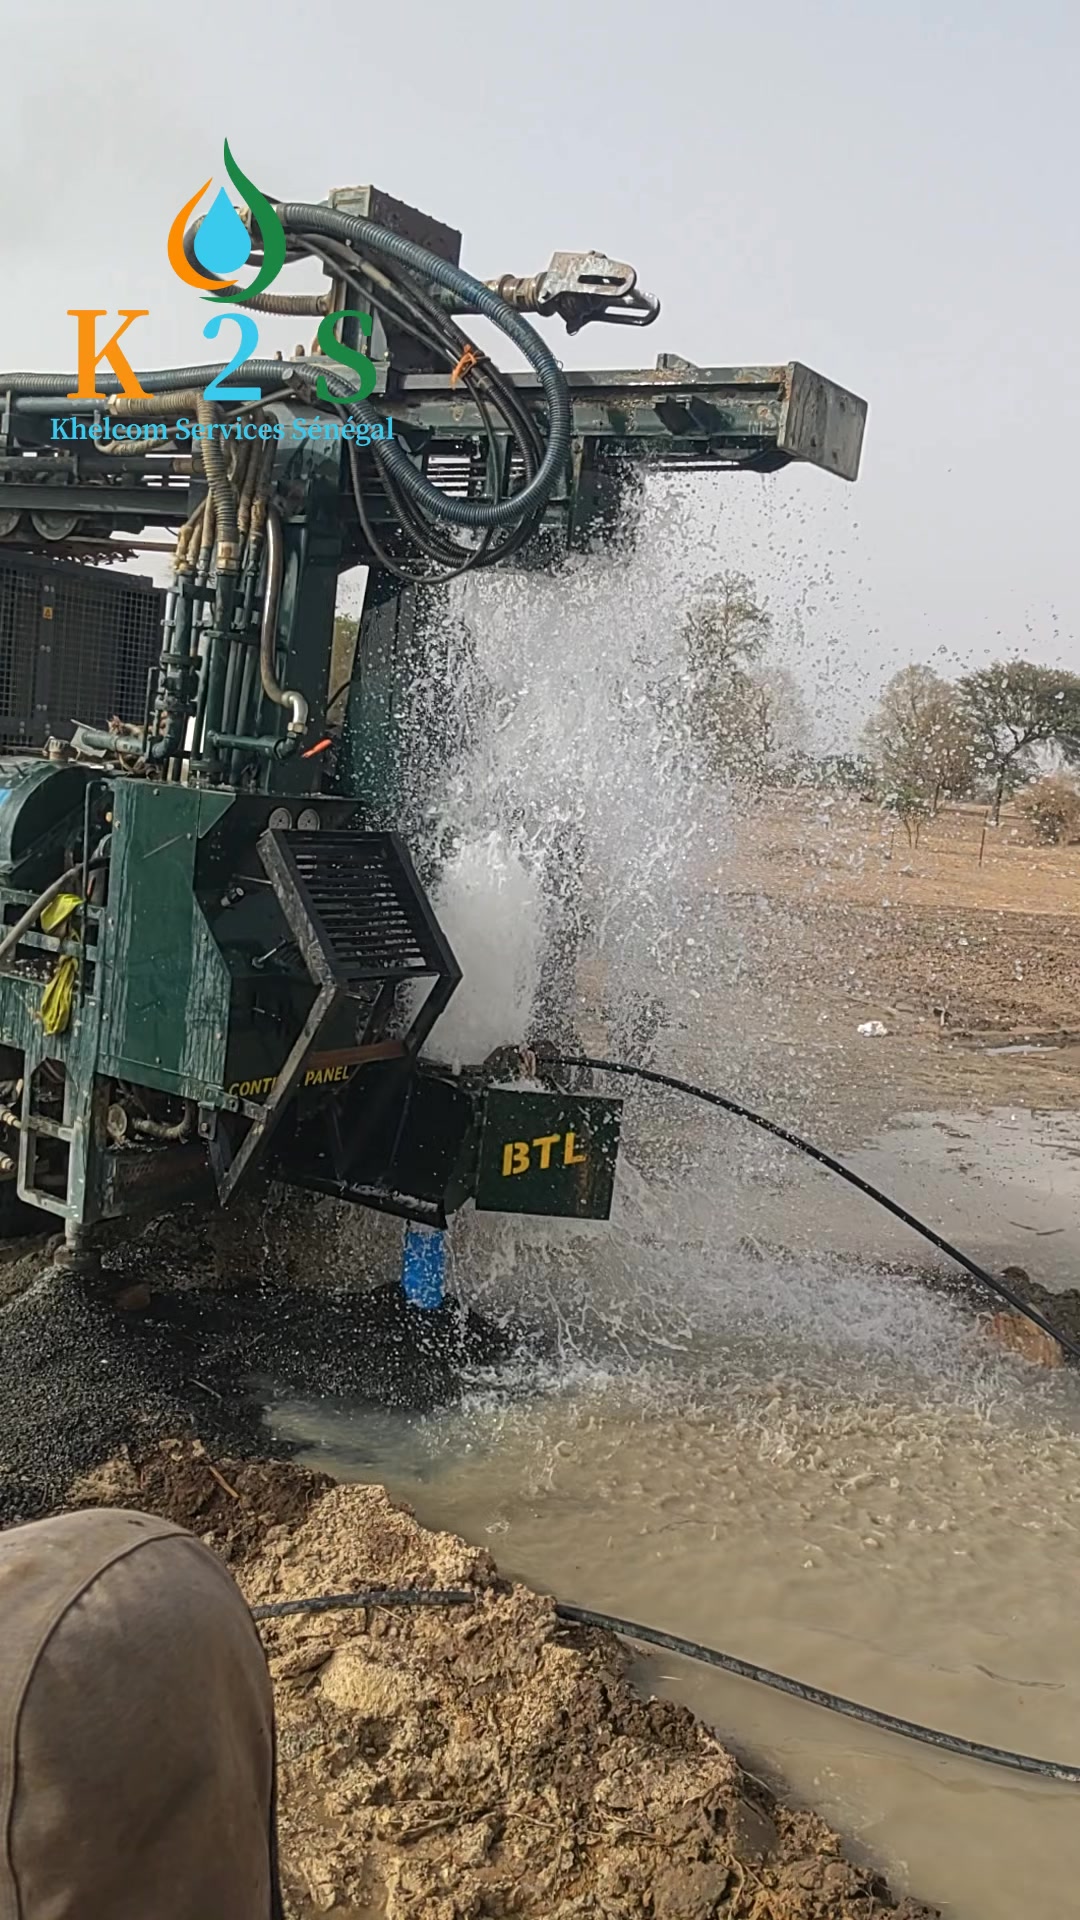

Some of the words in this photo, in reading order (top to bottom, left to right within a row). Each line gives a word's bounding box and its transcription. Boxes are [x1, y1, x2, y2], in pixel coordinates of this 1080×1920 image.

[229, 1075, 299, 1097] CONT
[304, 1065, 350, 1087] PANEL
[502, 1132, 587, 1177] BTL
